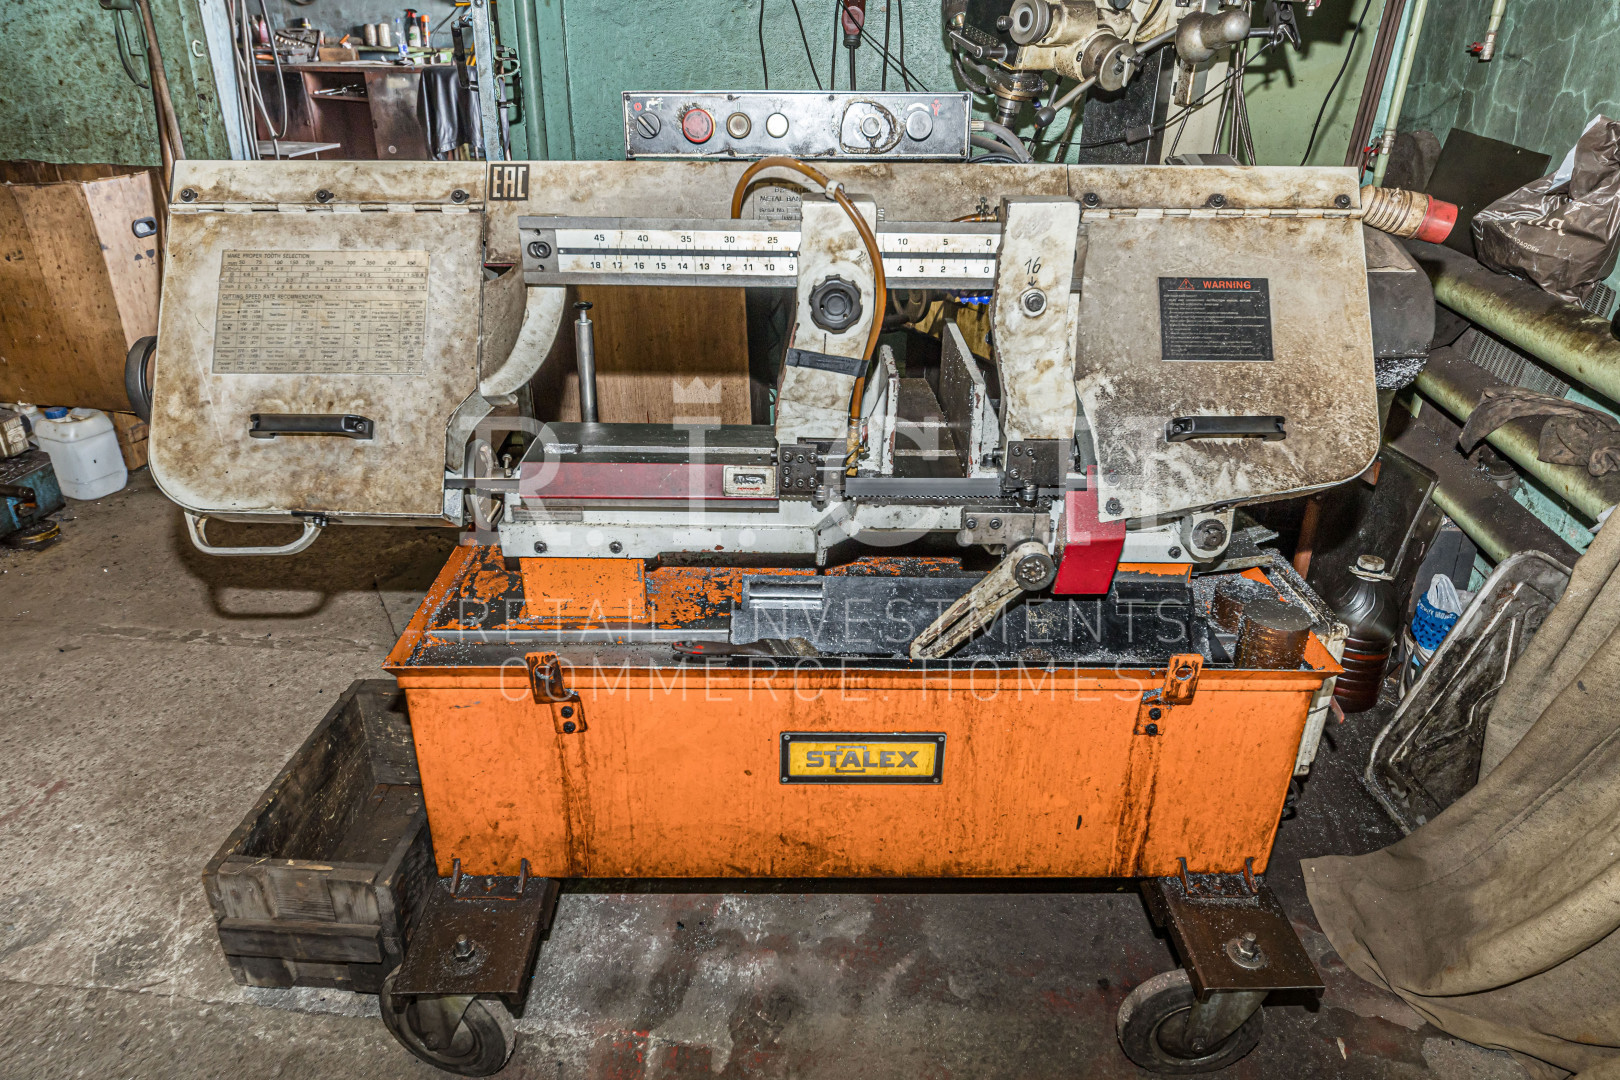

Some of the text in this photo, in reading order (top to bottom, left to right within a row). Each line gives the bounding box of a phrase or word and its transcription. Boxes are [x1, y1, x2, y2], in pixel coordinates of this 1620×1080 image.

[491, 166, 527, 198] EAC
[594, 234, 605, 242] 45
[680, 235, 692, 243] 35
[767, 236, 779, 244] 25
[897, 238, 992, 247] 10 5 0
[655, 262, 667, 270] 15
[721, 263, 732, 271] 12
[743, 263, 753, 271] 11
[764, 263, 775, 271] 10
[918, 265, 925, 273] 3
[1024, 256, 1042, 275] 16
[1202, 280, 1252, 289] WARNING
[805, 750, 920, 768] STALEX
